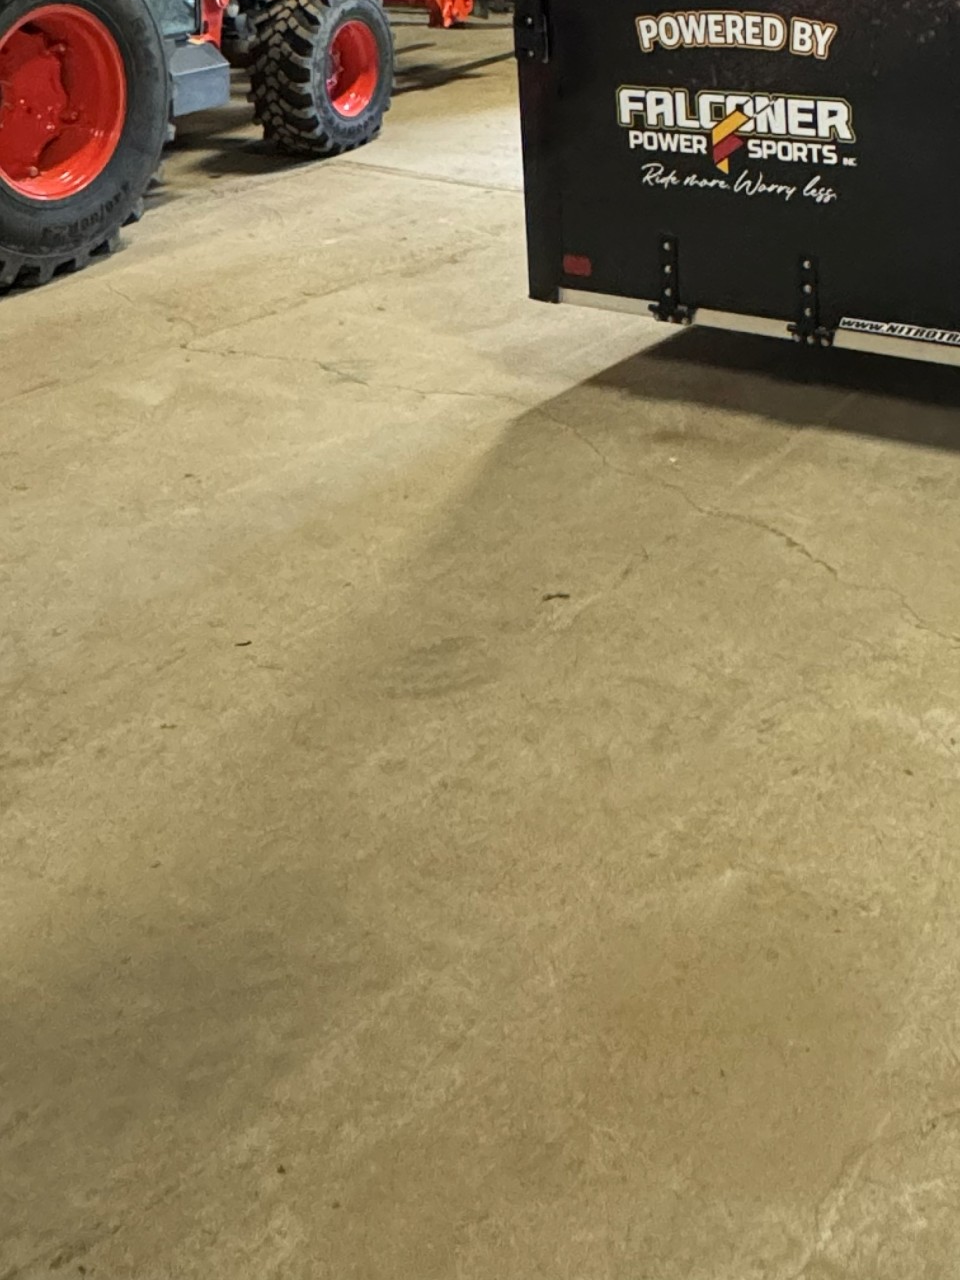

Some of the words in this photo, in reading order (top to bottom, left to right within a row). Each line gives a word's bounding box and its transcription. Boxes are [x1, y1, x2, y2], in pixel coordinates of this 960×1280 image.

[636, 10, 787, 52] POWERED
[789, 16, 838, 60] BY
[616, 85, 856, 143] FALCONER
[628, 129, 708, 155] POWER
[747, 138, 838, 165] SPORTS
[641, 163, 680, 189] Ride
[733, 170, 797, 201] Worry
